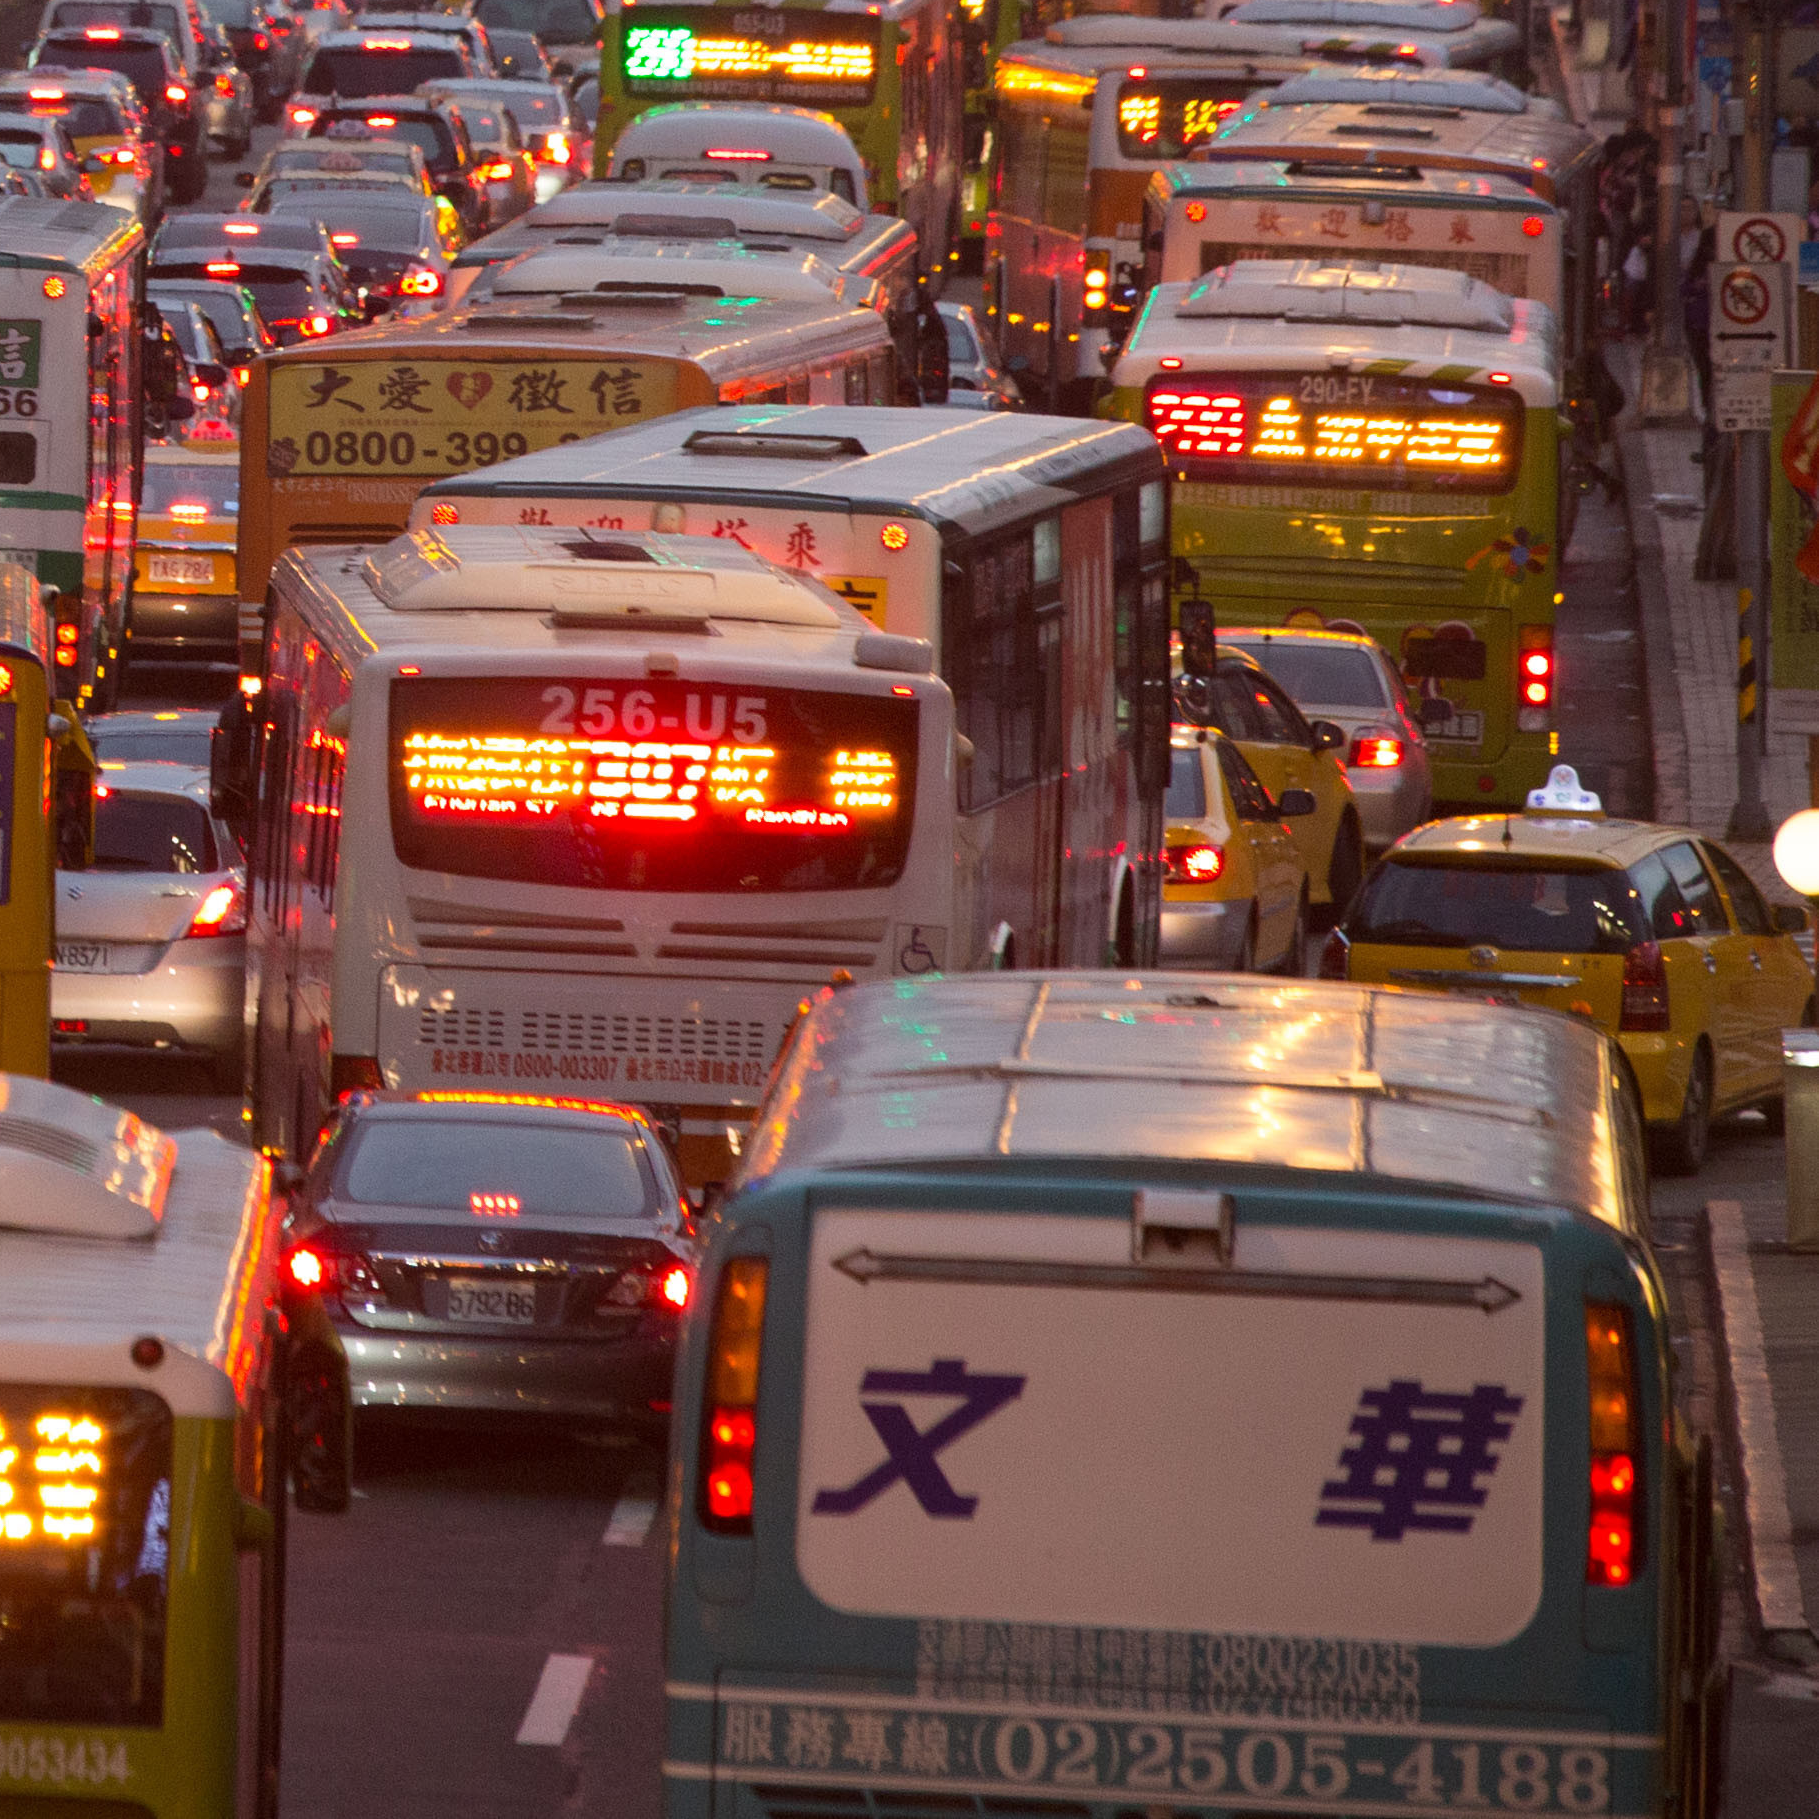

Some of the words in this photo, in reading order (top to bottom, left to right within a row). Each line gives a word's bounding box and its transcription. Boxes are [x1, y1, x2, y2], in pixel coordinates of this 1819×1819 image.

[306, 366, 435, 414] 大愛
[506, 367, 643, 416] 徵信
[1300, 375, 1375, 407] 290-FY
[537, 684, 769, 744] 256-U5
